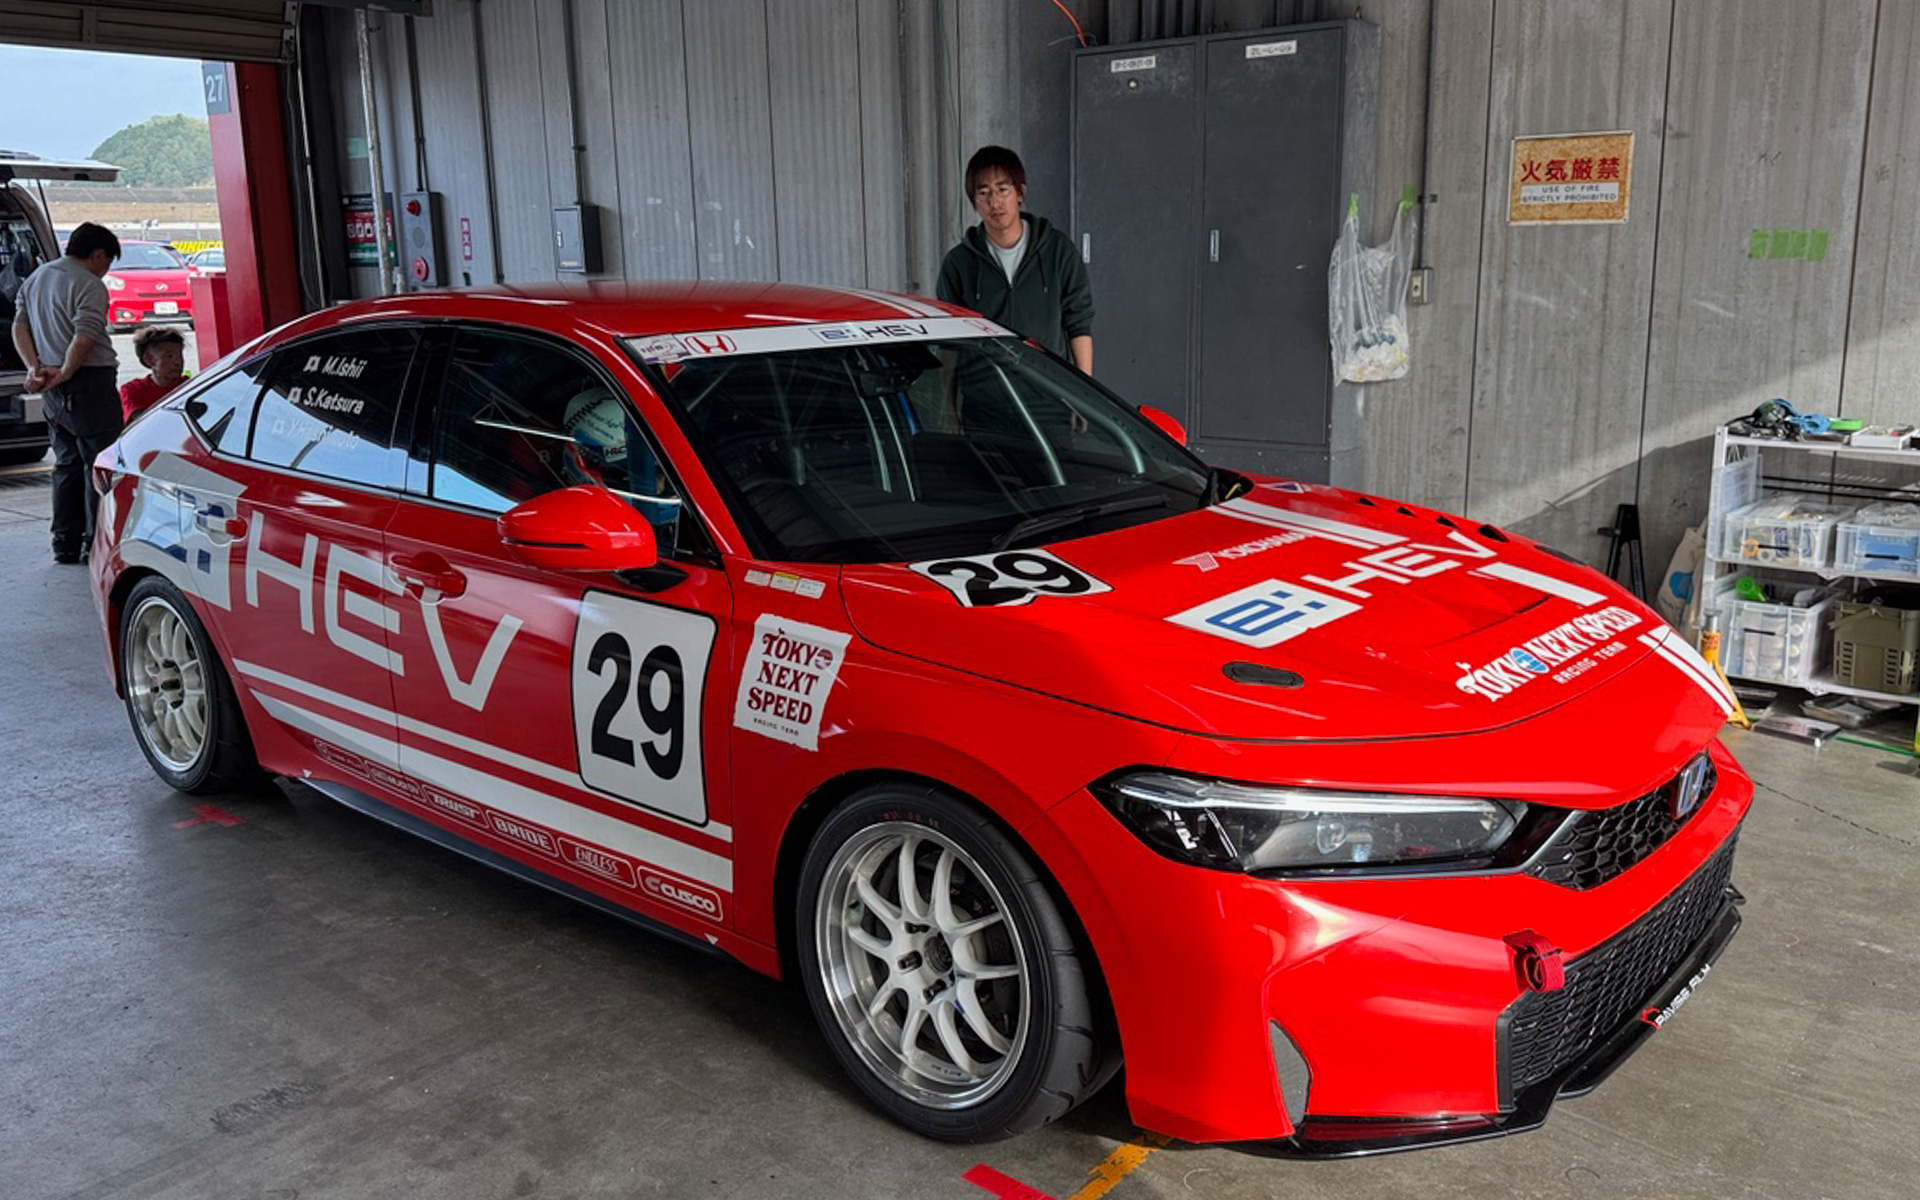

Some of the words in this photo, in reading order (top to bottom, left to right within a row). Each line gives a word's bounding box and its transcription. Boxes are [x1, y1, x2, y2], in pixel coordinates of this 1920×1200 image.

[205, 74, 224, 103] 27
[1520, 157, 1620, 182] 火気厳禁
[1522, 194, 1561, 203] STRICTLY
[1564, 192, 1617, 202] PROHIBITED
[1542, 185, 1560, 194] USE
[1564, 185, 1576, 193] OF
[1580, 184, 1600, 192] FIRE
[322, 355, 368, 379] M.Ishii
[303, 386, 365, 415] S.Katsura
[927, 552, 1092, 608] 29
[762, 629, 834, 670] TOKYO
[1455, 646, 1550, 702] TOKYO
[1522, 622, 1596, 668] NEXT
[1572, 605, 1643, 642] SPEED
[1551, 657, 1599, 685] RACING
[1593, 640, 1629, 660] TEAM
[756, 659, 820, 697] NEXT
[587, 631, 685, 781] 29
[746, 686, 813, 725] SPEED
[428, 792, 480, 819] TRUST
[494, 819, 551, 850] BRIDE
[574, 845, 620, 875] ENDLESS
